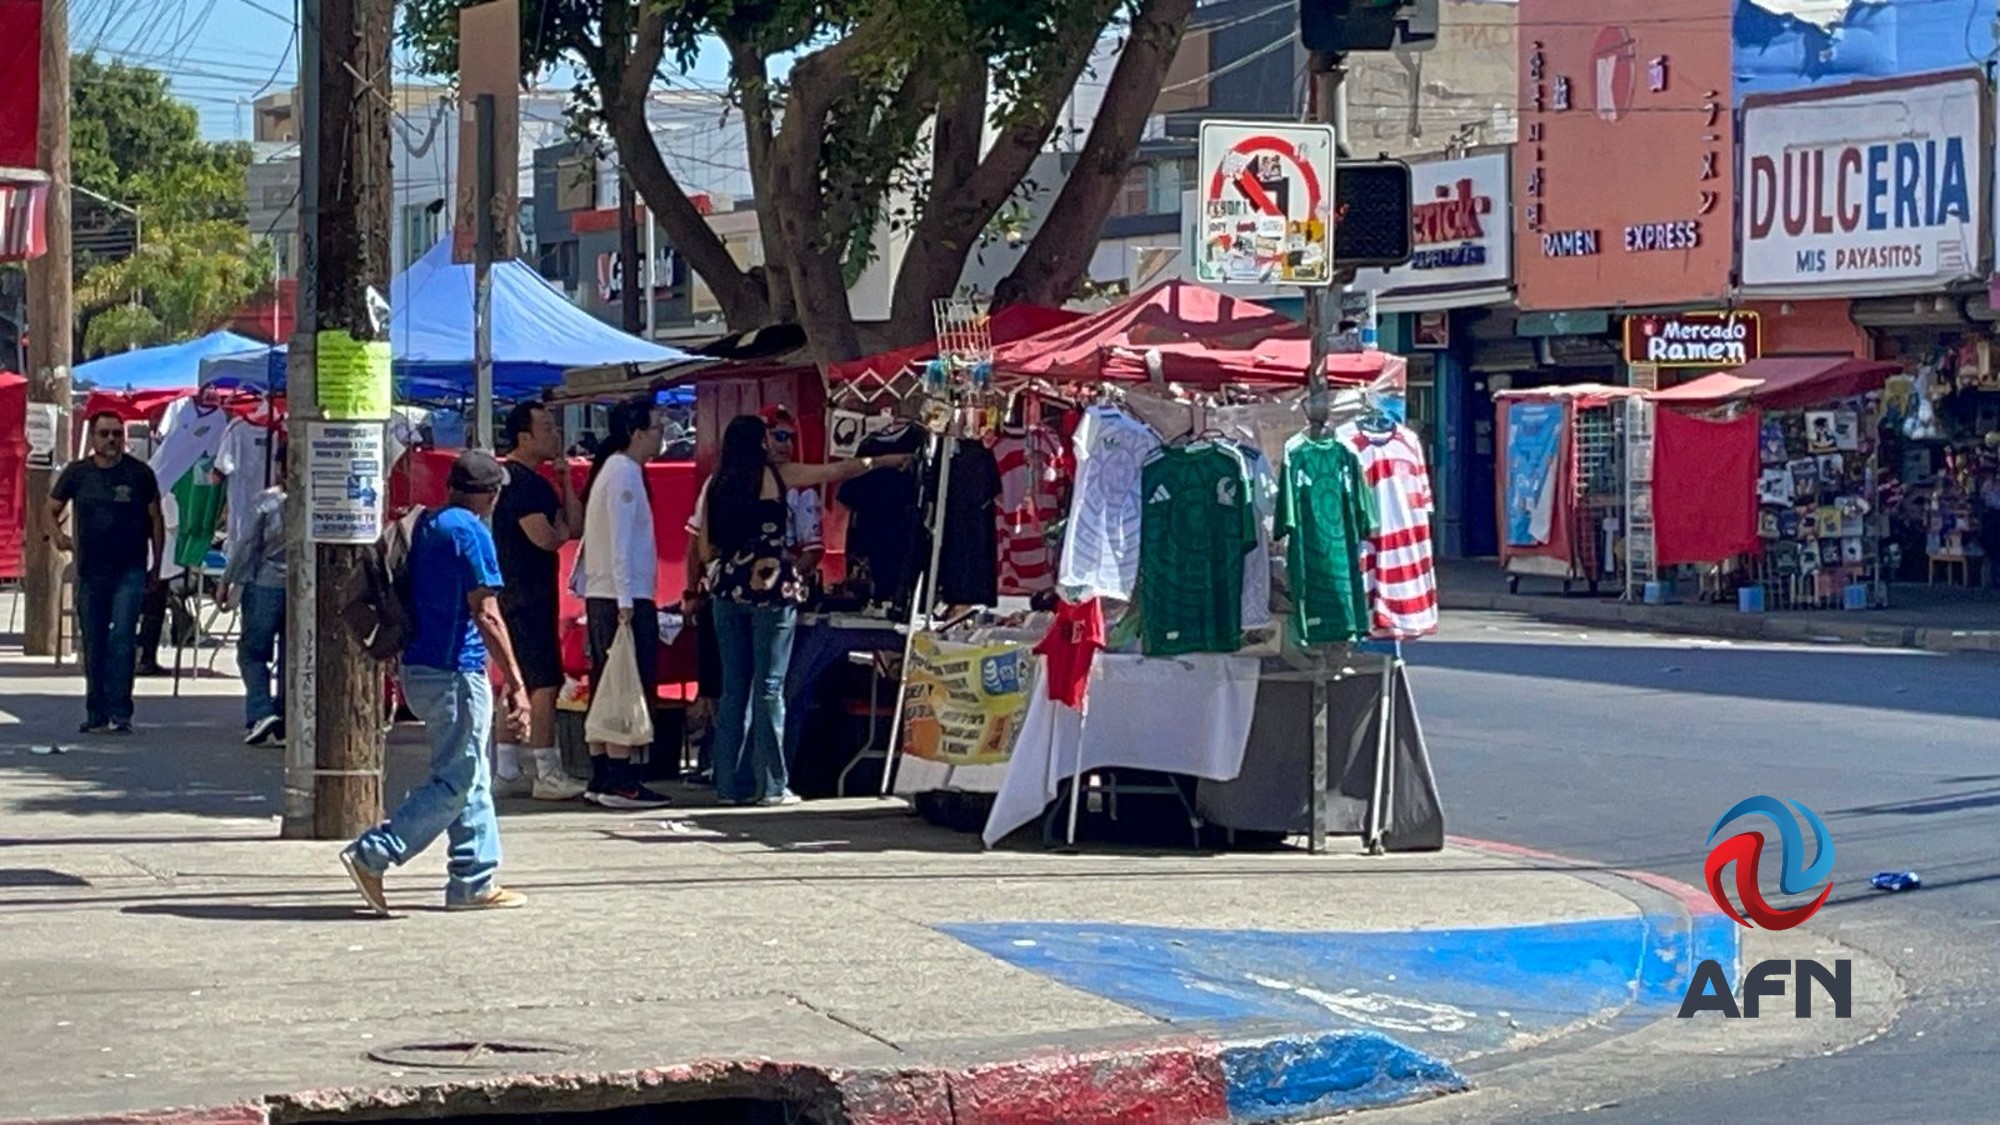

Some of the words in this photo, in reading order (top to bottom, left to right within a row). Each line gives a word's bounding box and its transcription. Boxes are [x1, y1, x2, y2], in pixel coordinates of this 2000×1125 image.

[1750, 136, 1971, 240] DULCERIA
[1412, 178, 1491, 246] erick
[1541, 229, 1597, 257] RAMEN
[1624, 221, 1698, 251] EXPRESS
[1796, 249, 1826, 273] MIS
[1835, 244, 1922, 270] PAYASITOS
[1663, 315, 1747, 340] Mercado
[1648, 336, 1746, 362] Ramen
